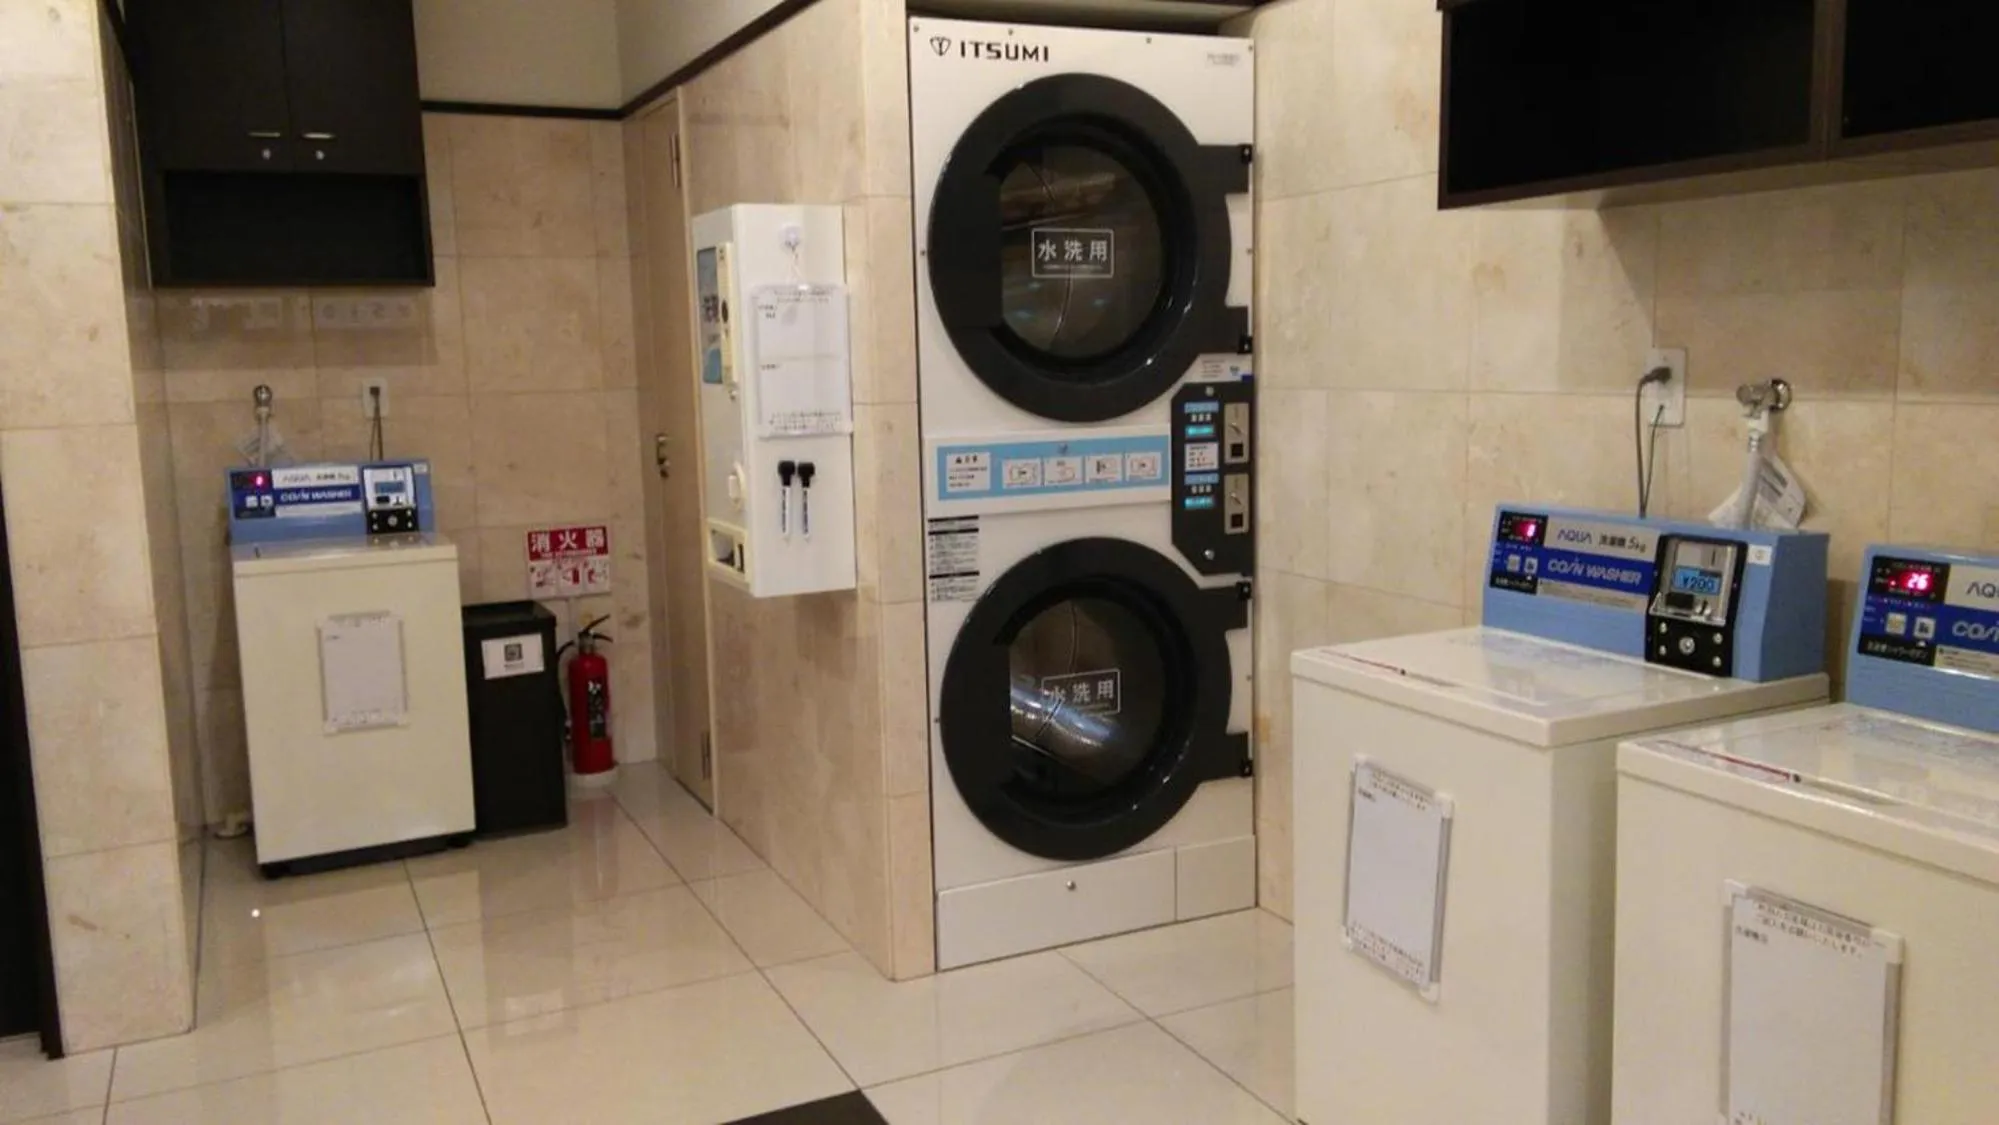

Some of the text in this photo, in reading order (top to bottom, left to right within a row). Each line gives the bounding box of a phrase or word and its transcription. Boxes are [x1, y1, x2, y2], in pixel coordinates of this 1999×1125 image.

[960, 41, 1049, 62] ITSUMI
[1038, 240, 1108, 262] 水洗用
[1586, 565, 1642, 586] WASHER
[1908, 573, 1929, 589] 26
[1966, 581, 1999, 599] AQ
[1050, 679, 1114, 702] 水洗用
